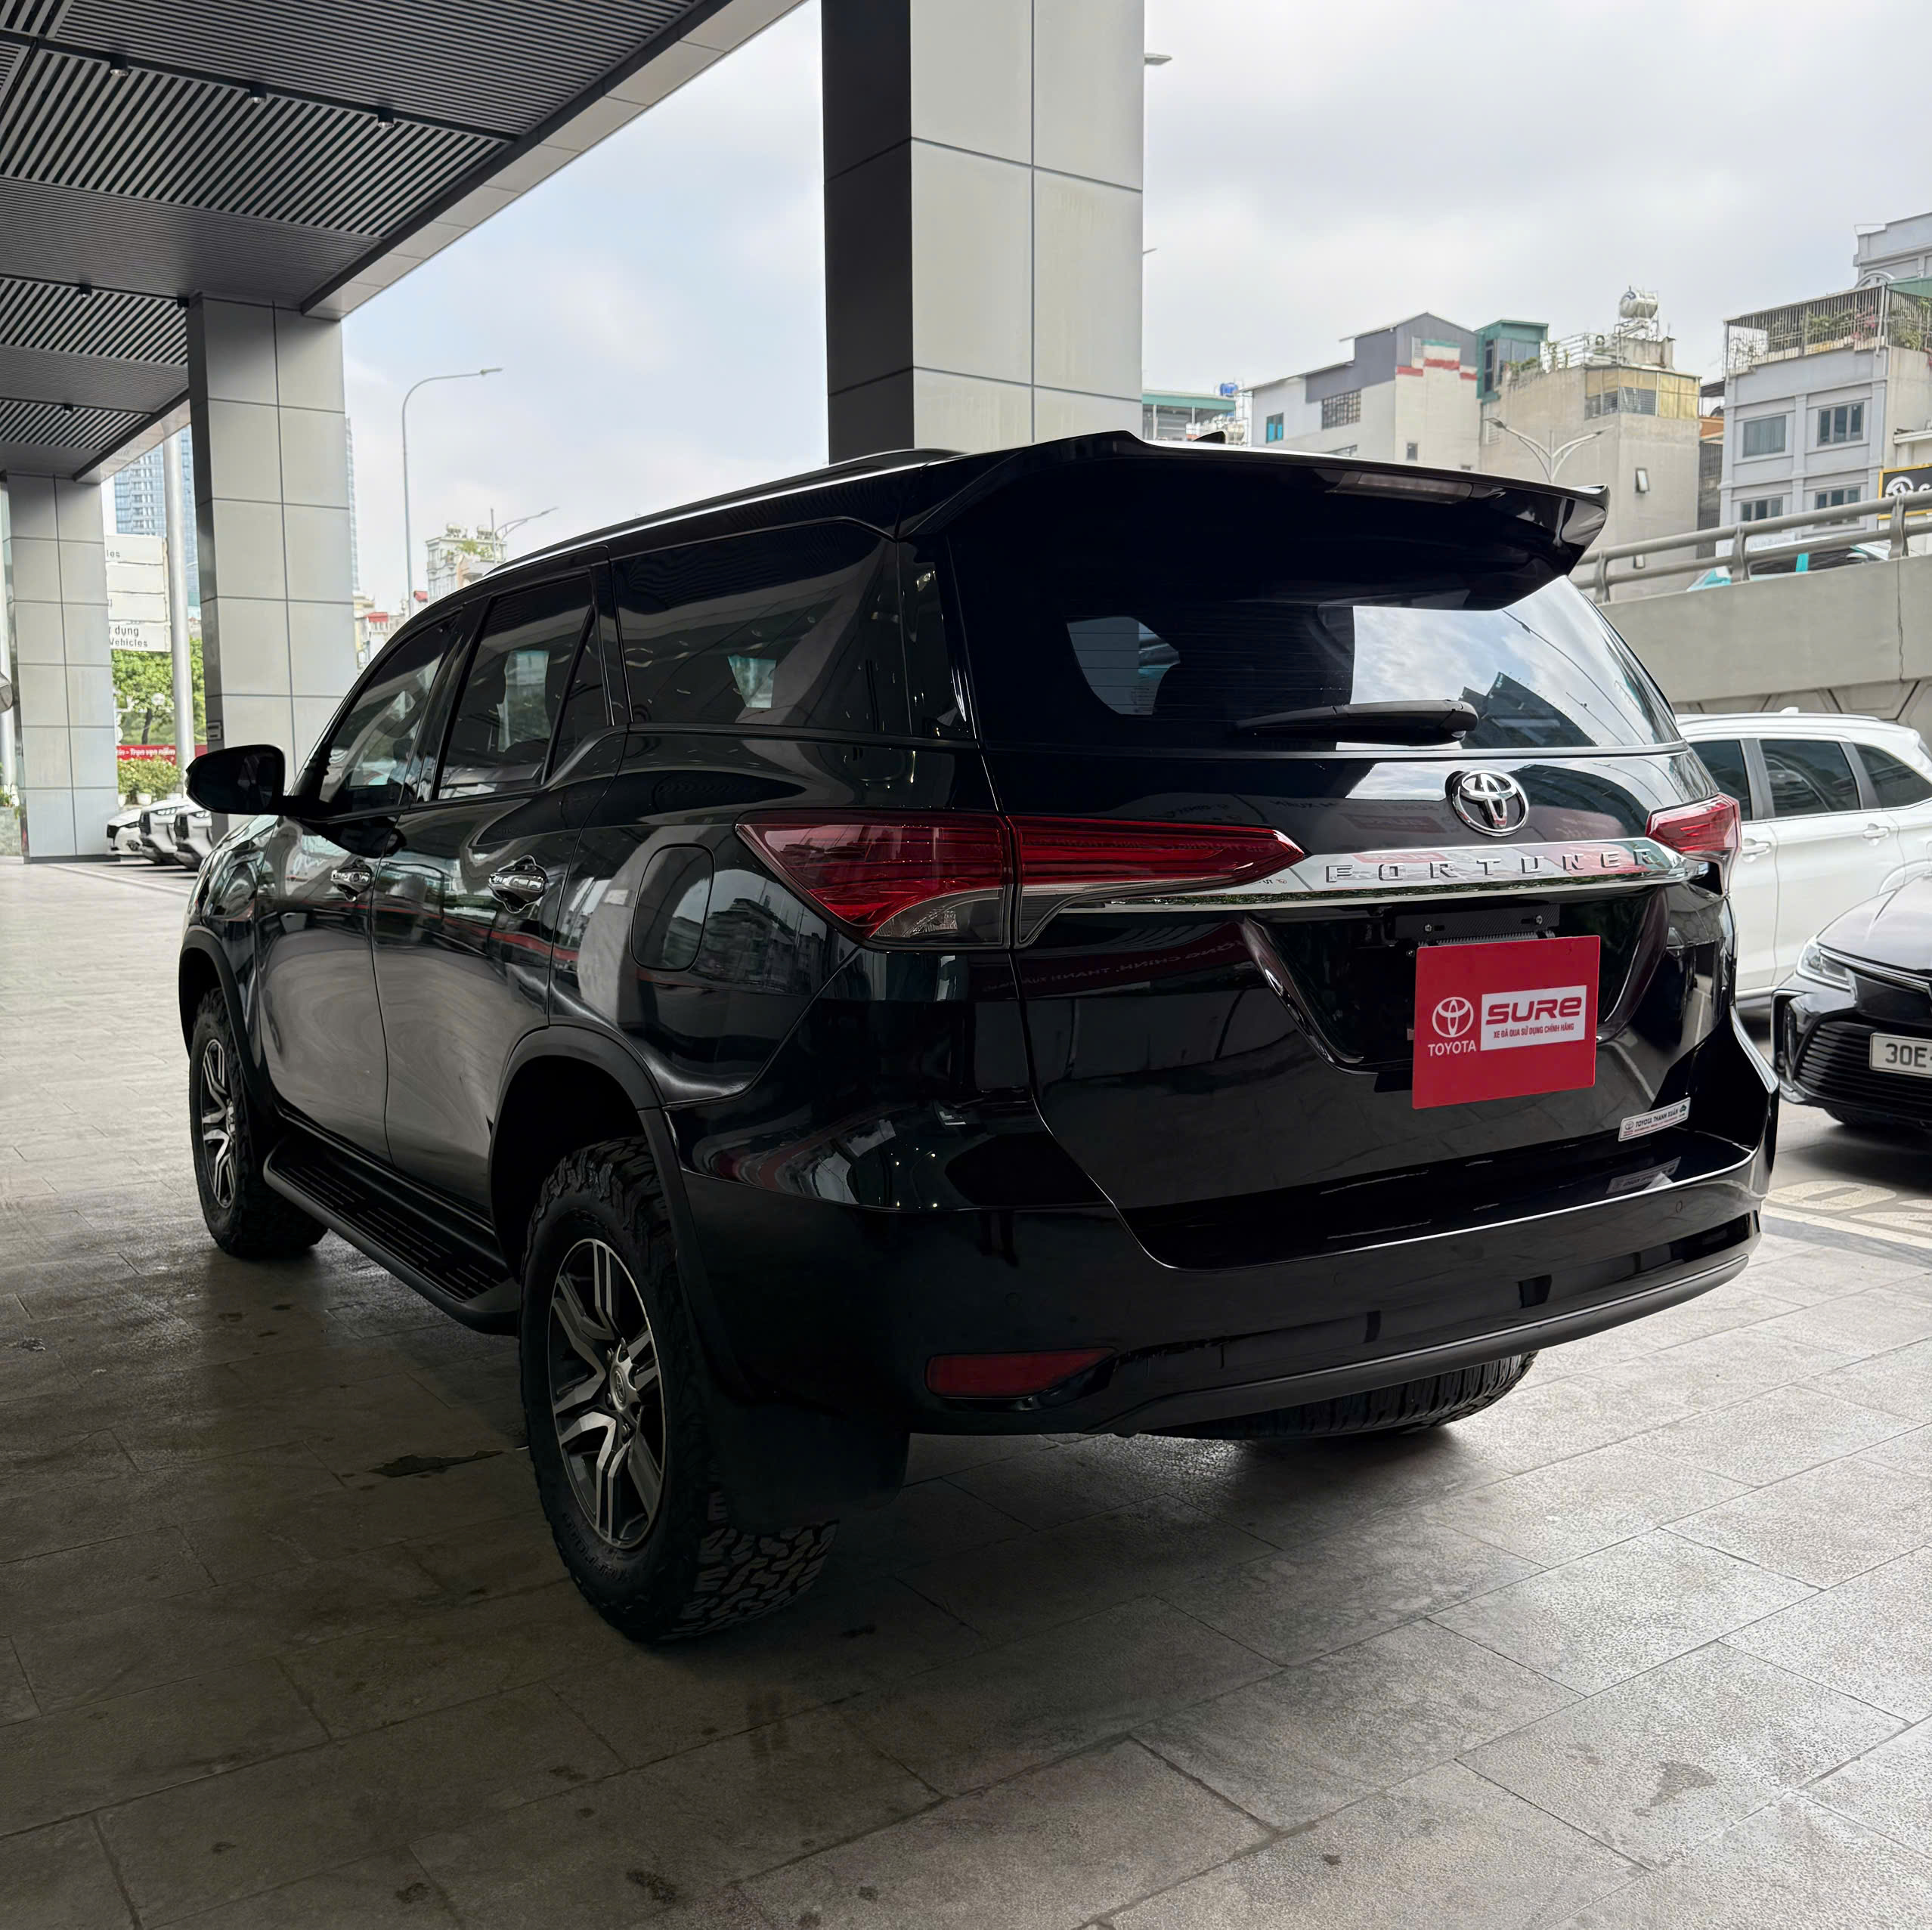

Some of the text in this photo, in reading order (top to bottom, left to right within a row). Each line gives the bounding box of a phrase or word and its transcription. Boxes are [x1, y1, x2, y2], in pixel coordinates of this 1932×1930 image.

[115, 626, 139, 637] dụng
[109, 638, 148, 648] Vehicles
[1326, 849, 1660, 883] FORTUNER
[1494, 1031, 1500, 1039] XE
[1509, 1028, 1521, 1037] QUA
[1529, 1026, 1543, 1035] DỤNG
[1428, 1041, 1477, 1056] TOYOTA
[1636, 1118, 1652, 1127] TOYOTA
